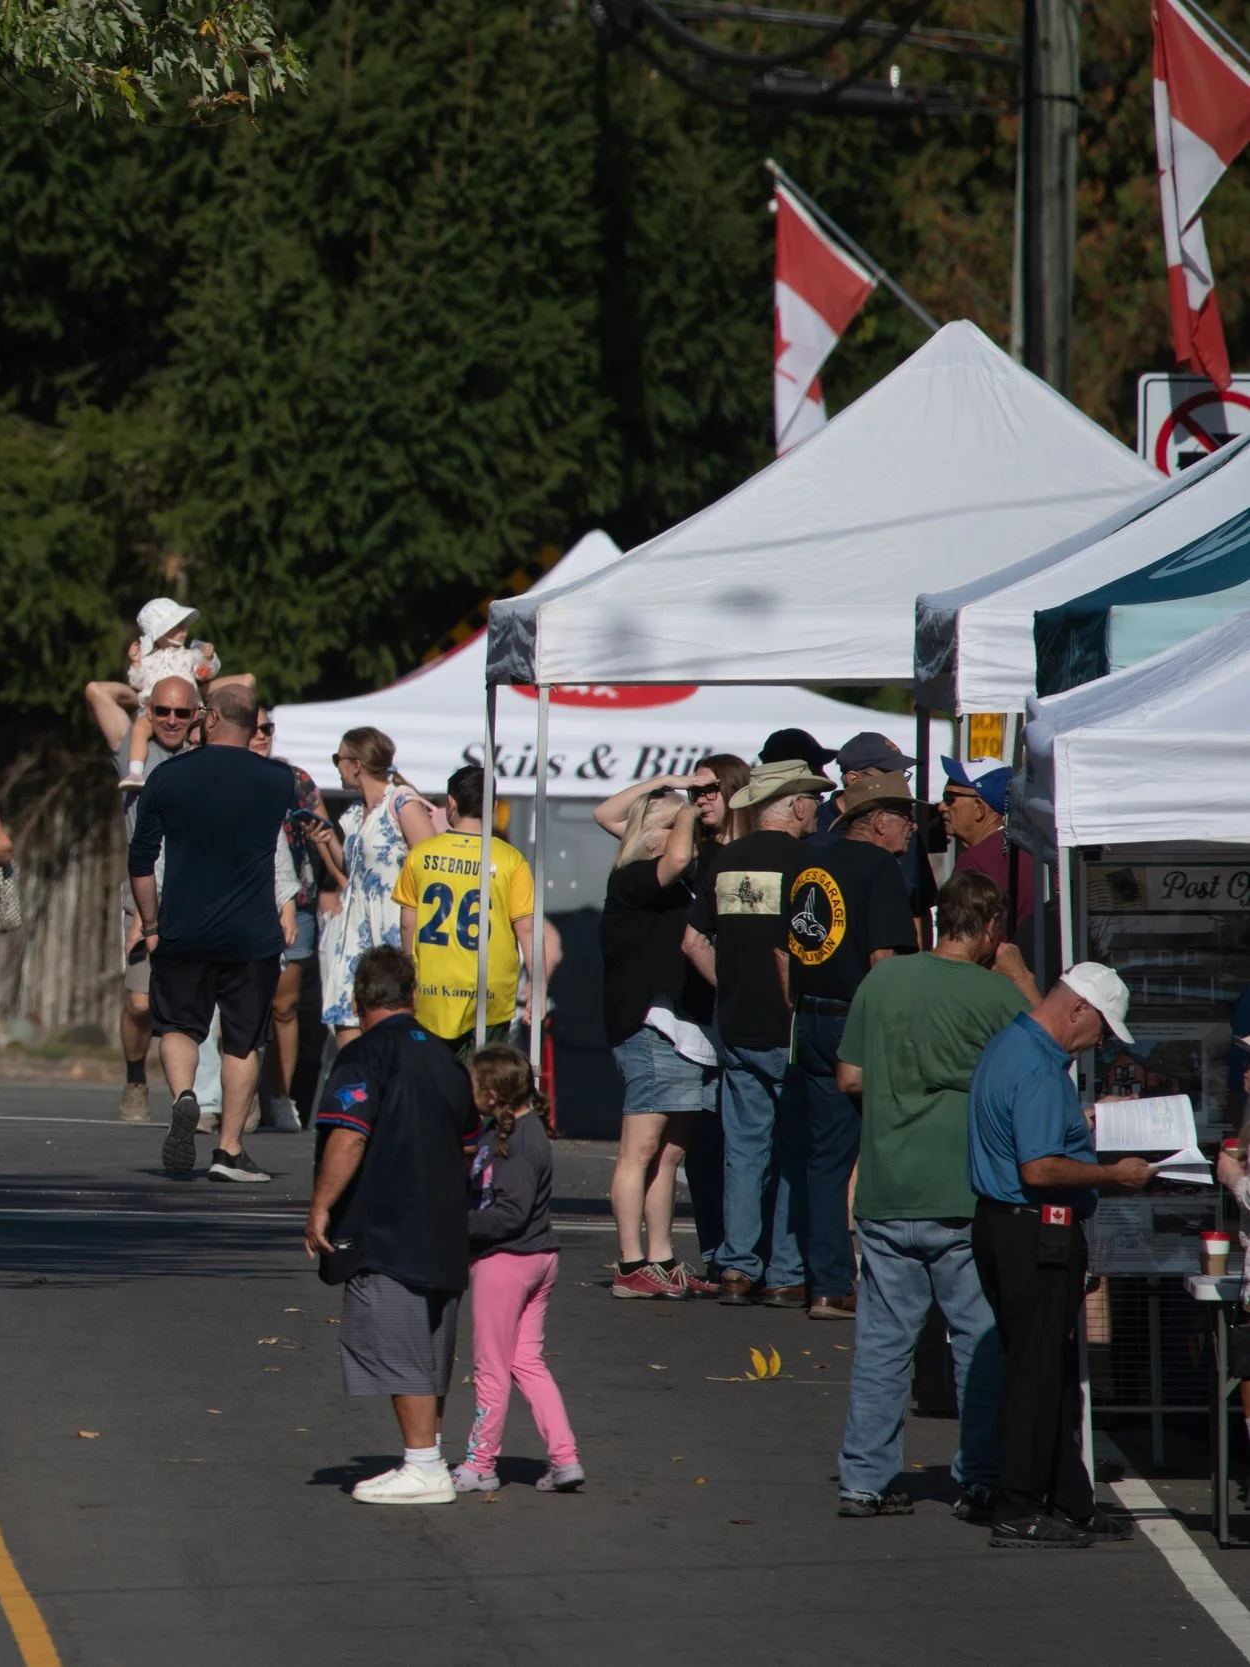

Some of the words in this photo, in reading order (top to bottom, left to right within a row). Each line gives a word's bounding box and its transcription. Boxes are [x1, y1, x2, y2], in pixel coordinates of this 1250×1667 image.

[575, 744, 618, 780] &
[819, 873, 844, 928] GARAGE
[1161, 871, 1221, 899] Post
[419, 882, 492, 951] 26
